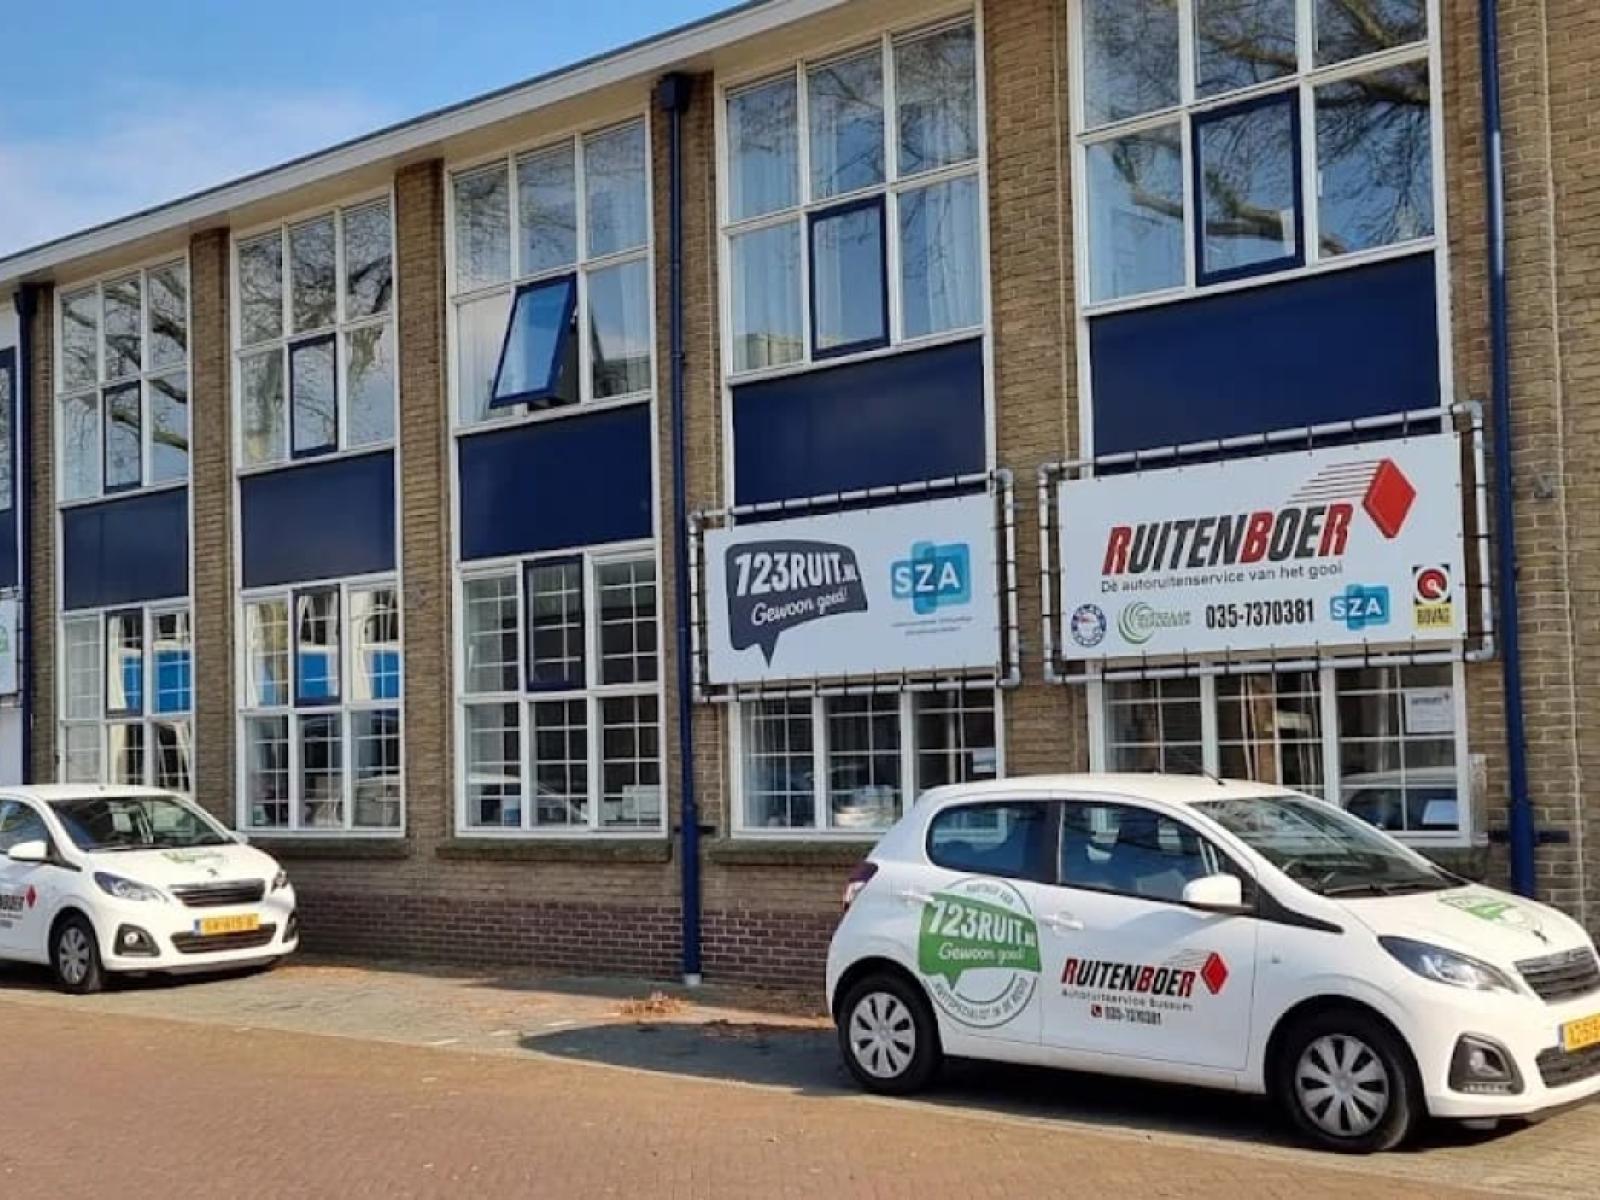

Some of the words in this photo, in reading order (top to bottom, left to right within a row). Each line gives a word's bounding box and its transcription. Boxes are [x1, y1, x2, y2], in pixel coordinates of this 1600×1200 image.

[1102, 503, 1353, 575] RUITENBOER
[895, 561, 961, 593] SZA
[1101, 580, 1118, 593] De
[1122, 571, 1244, 592] autoruitenservice
[1248, 569, 1276, 581] van
[1281, 564, 1304, 578] het
[1308, 562, 1343, 580] gooi
[751, 602, 814, 626] Gewoon
[1205, 598, 1315, 629] 035-7370381
[1333, 597, 1382, 618] SZA
[939, 942, 996, 961] Gewoon
[1062, 958, 1196, 997] RUITENBOER
